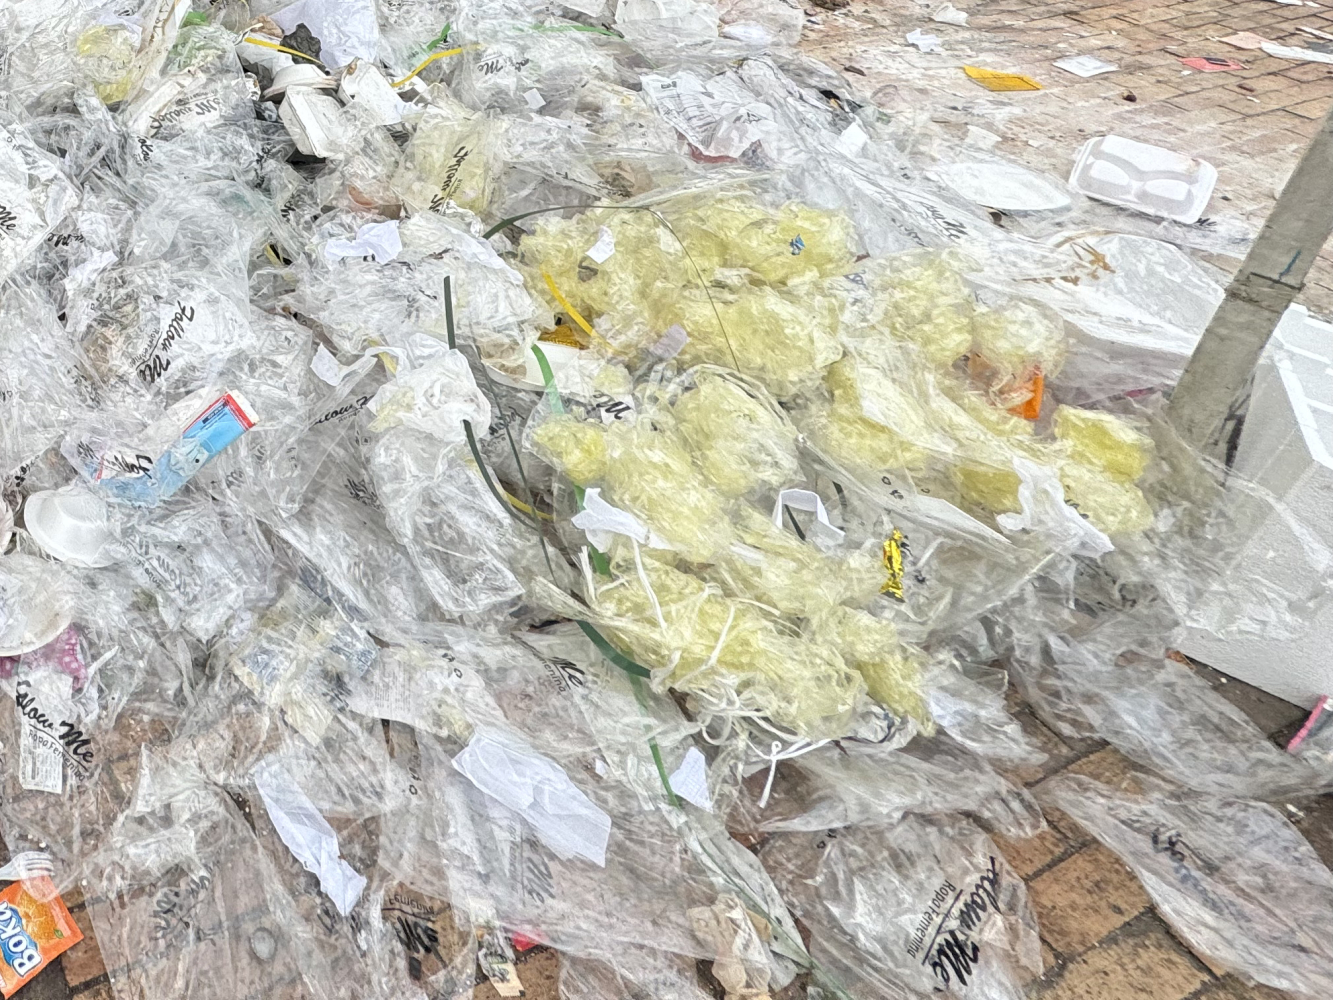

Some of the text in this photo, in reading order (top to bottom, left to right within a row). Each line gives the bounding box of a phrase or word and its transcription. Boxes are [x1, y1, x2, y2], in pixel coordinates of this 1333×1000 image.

[137, 300, 195, 384] Follow Me
[59, 720, 94, 763] Me
[906, 879, 957, 960] Ropa Femenina
[931, 930, 980, 987] Me
